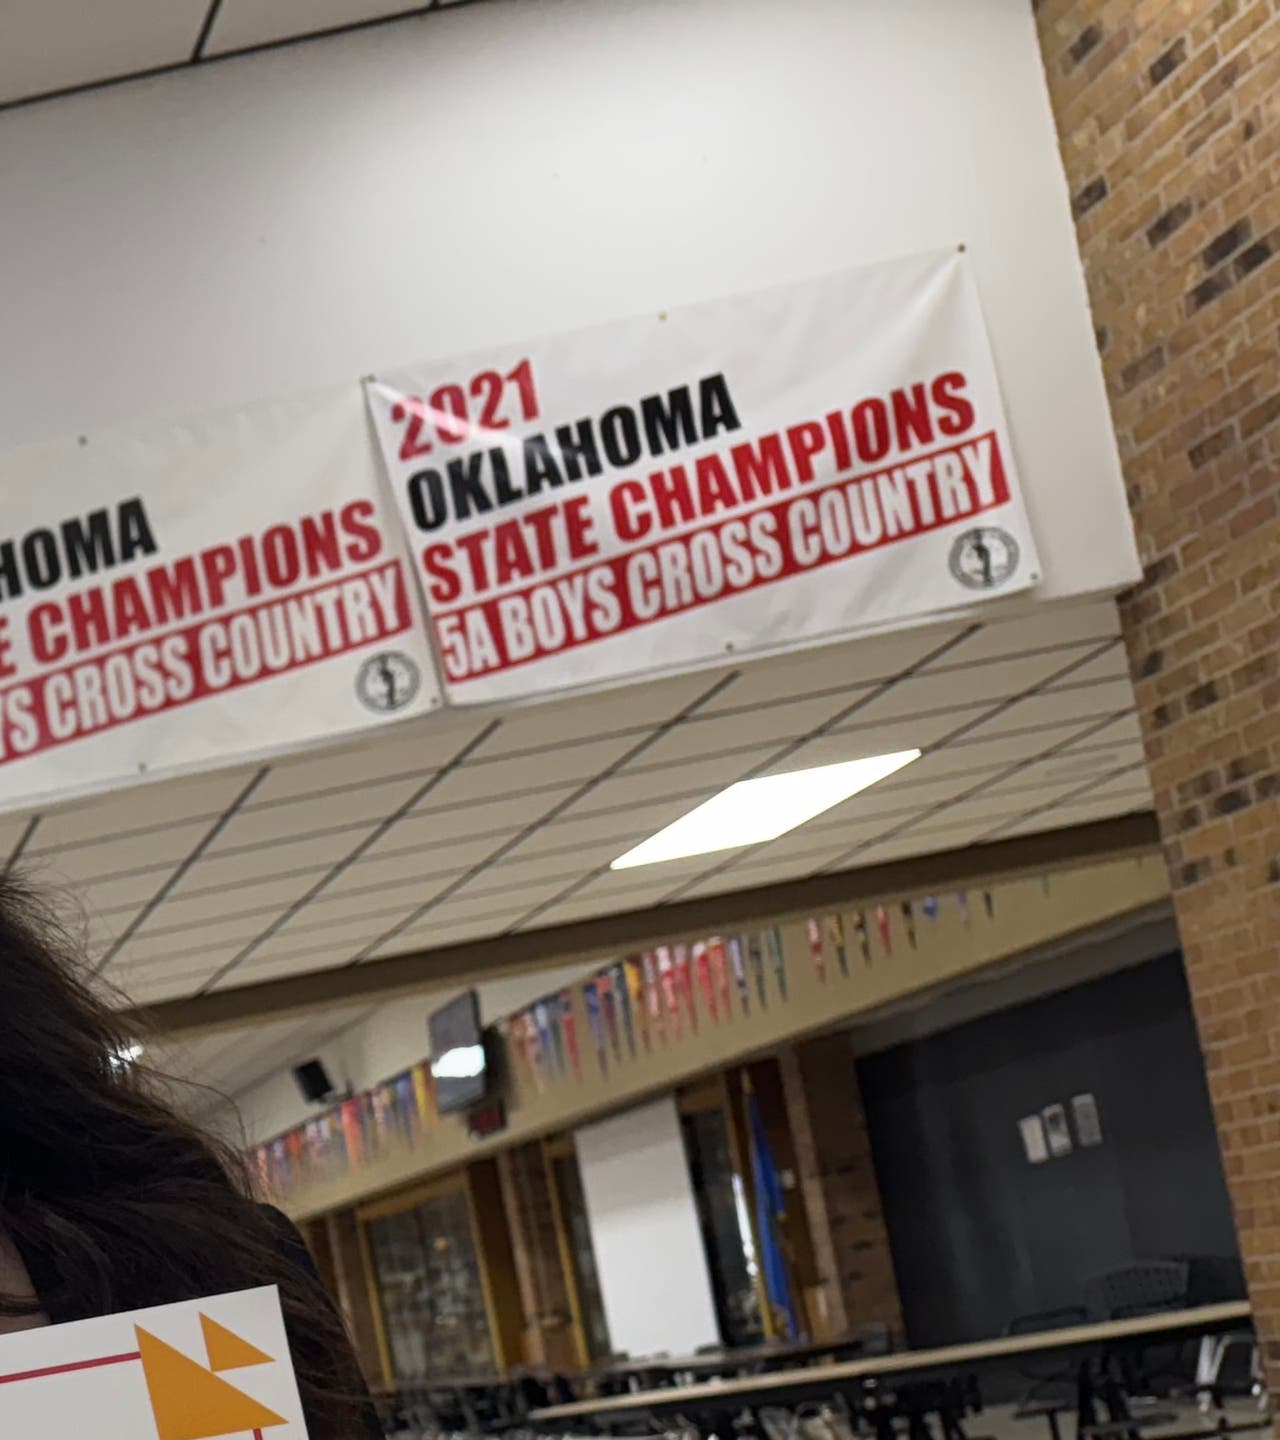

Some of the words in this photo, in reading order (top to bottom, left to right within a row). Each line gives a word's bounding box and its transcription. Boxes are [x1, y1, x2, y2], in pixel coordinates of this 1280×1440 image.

[392, 357, 541, 462] 2021
[407, 371, 741, 533] OKLAHOMA
[421, 494, 598, 604] STATE
[609, 371, 975, 543] CHAMPIONS
[26, 499, 382, 664] CHAMPIONS
[438, 606, 500, 681] 5A
[499, 564, 622, 664] BOYS
[626, 510, 783, 619] CROSS
[788, 438, 994, 566] COUNTRY
[43, 634, 195, 740] CROSS
[198, 564, 401, 689] COUNTRY
